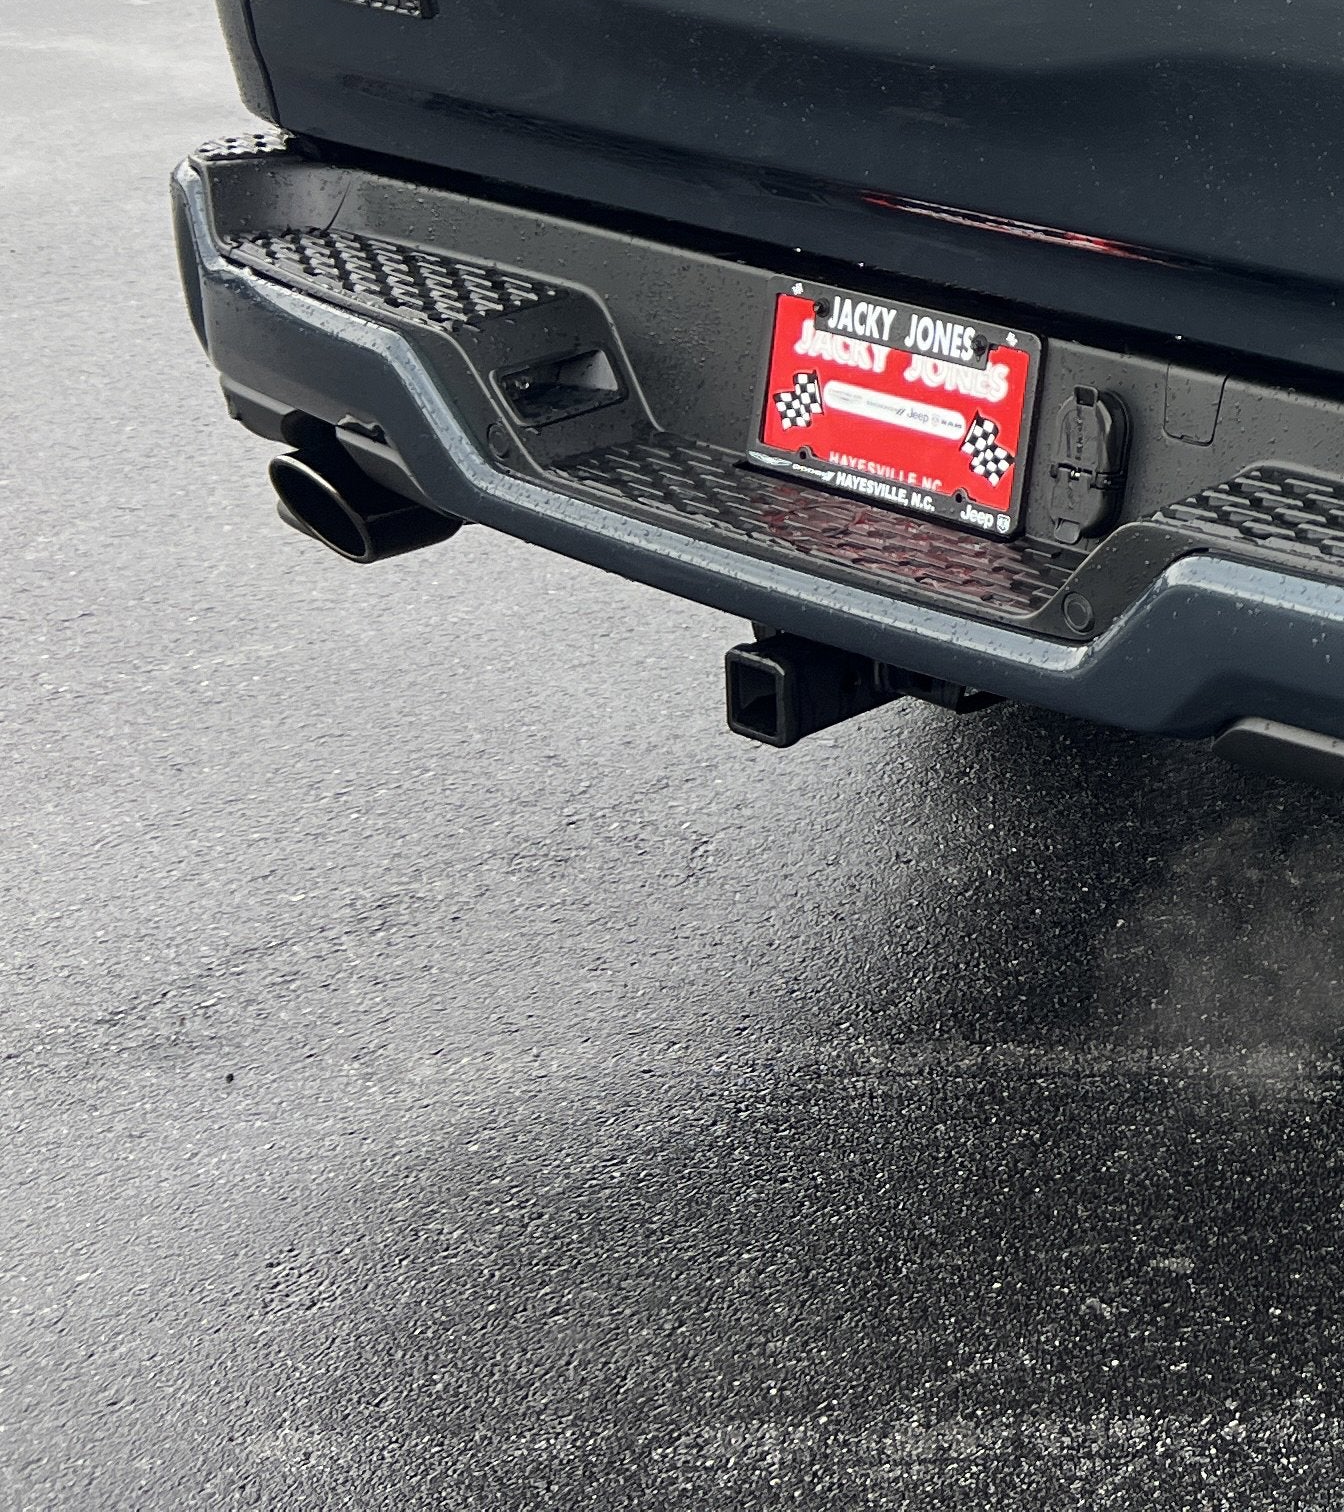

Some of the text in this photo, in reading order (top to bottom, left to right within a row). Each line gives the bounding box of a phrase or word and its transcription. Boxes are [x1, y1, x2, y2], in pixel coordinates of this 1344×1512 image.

[827, 295, 977, 361] JACKY JONES
[906, 407, 929, 425] Jeep
[835, 471, 909, 507] HAYESVILLE,
[960, 503, 994, 529] Jeep
